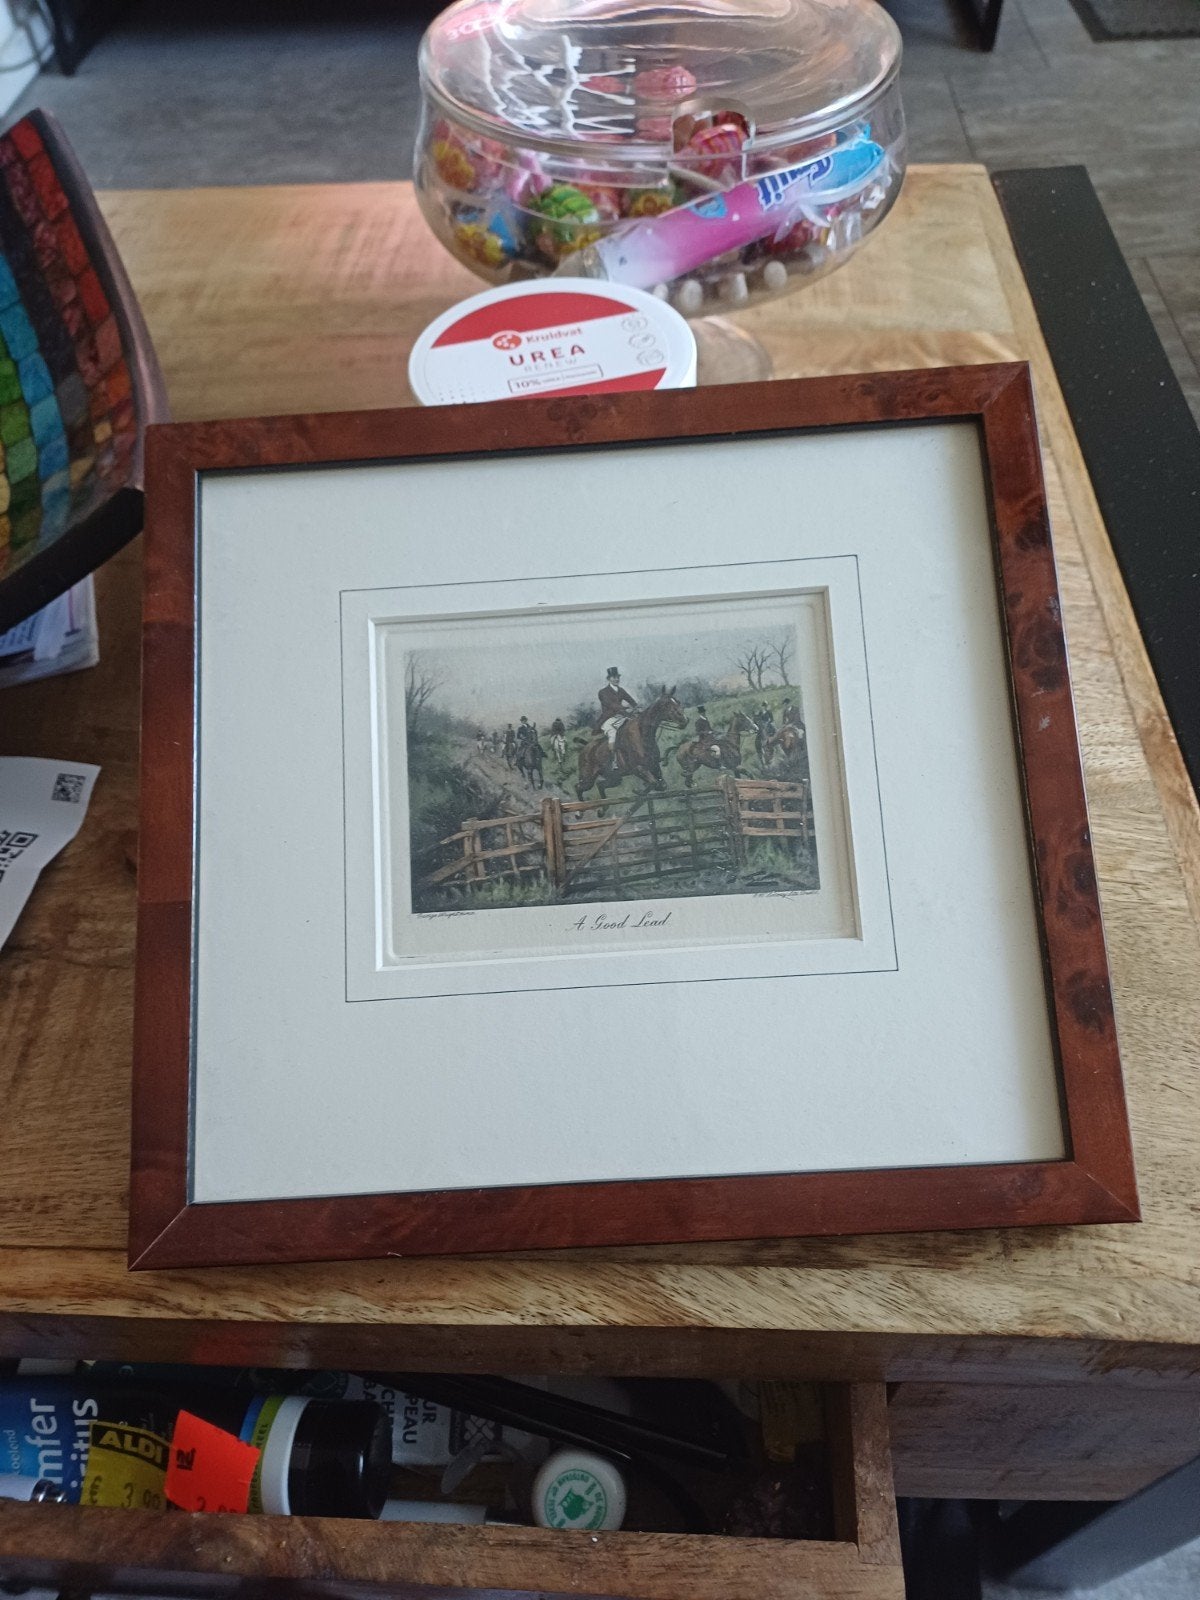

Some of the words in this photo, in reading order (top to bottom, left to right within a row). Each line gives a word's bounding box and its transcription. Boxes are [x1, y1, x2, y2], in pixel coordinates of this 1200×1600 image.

[526, 327, 584, 344] Kruidvat
[509, 344, 586, 366] UREA
[566, 915, 586, 932] A
[590, 912, 627, 931] Good
[631, 911, 673, 929] Lead
[24, 1397, 64, 1486] mfer
[98, 1430, 164, 1465] ALDI
